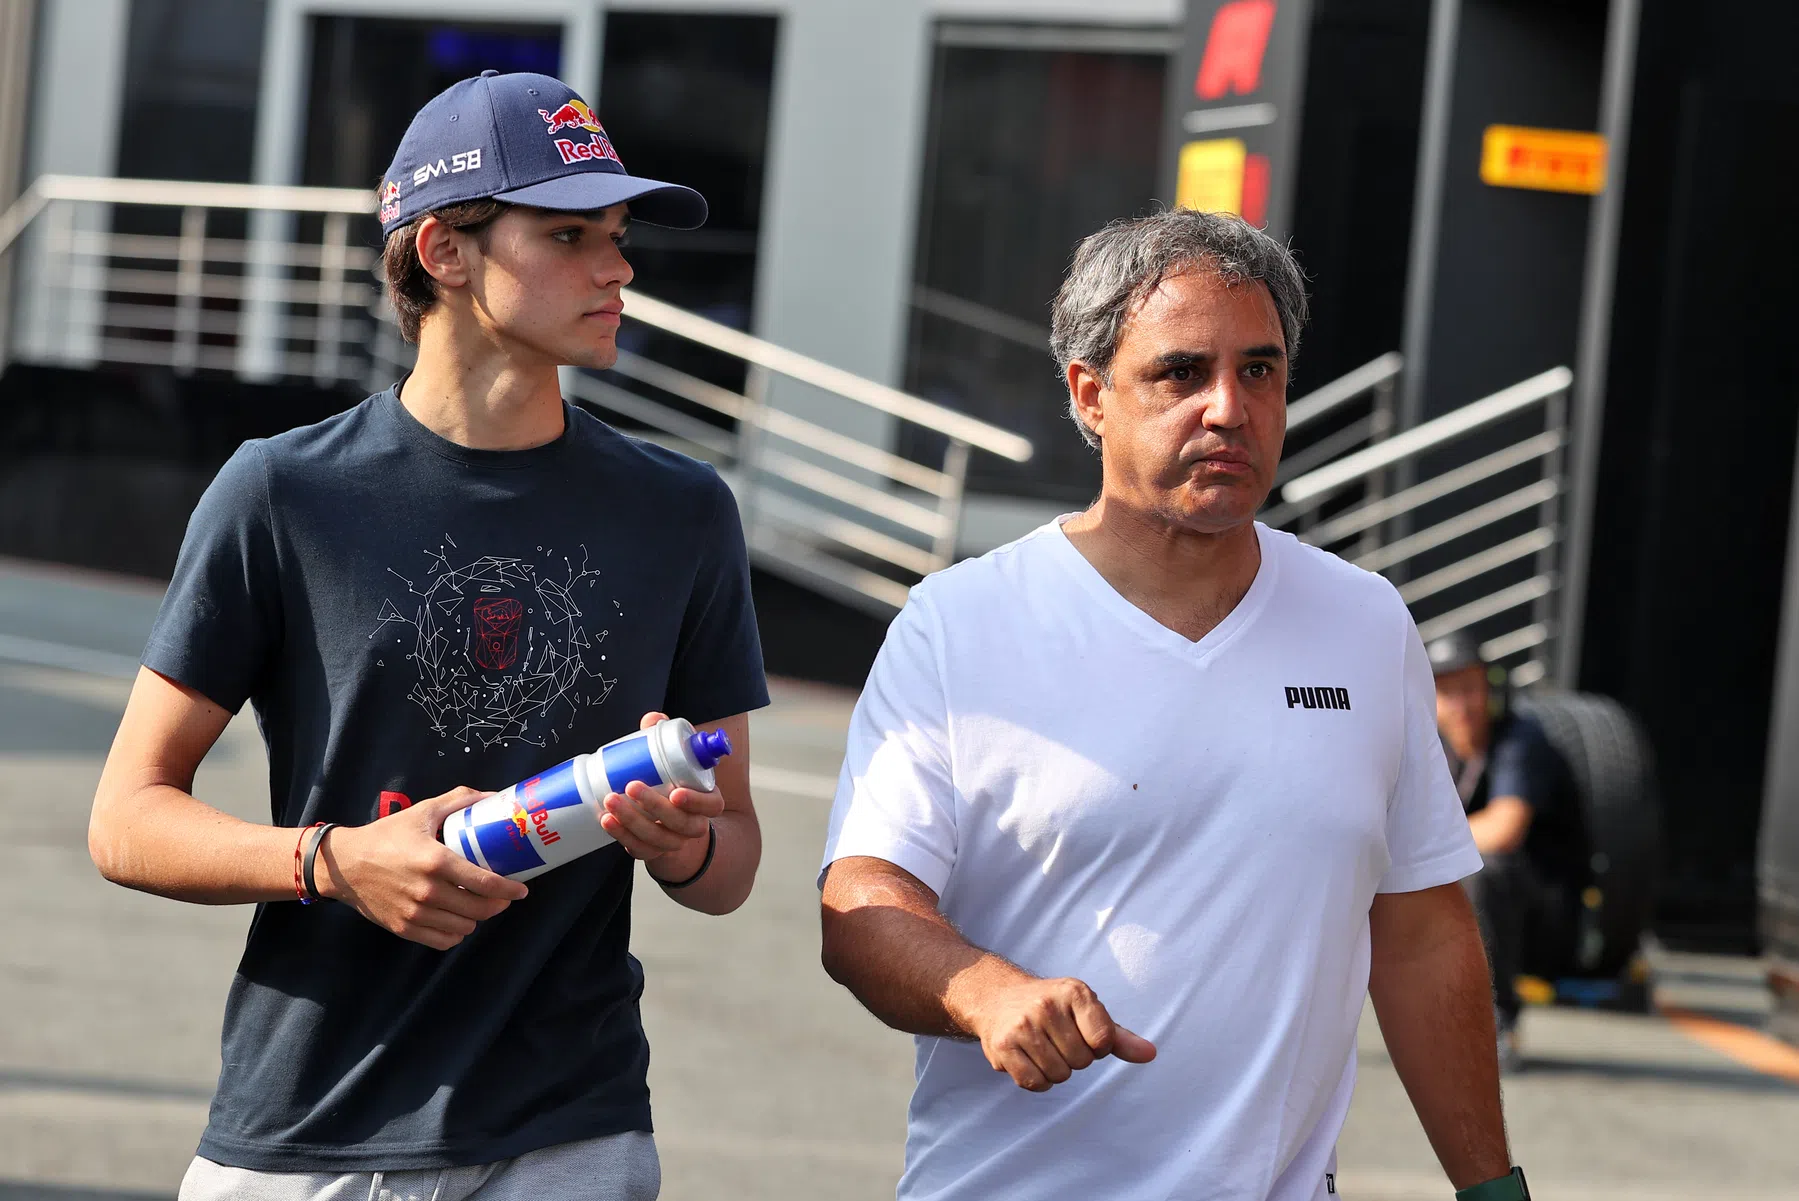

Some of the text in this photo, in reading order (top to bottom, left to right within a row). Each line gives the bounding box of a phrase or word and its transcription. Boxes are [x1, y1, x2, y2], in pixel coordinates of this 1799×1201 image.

[555, 134, 607, 164] Red
[413, 148, 482, 186] SM 58
[1284, 686, 1351, 710] PUMA
[524, 777, 561, 846] Red Bull
